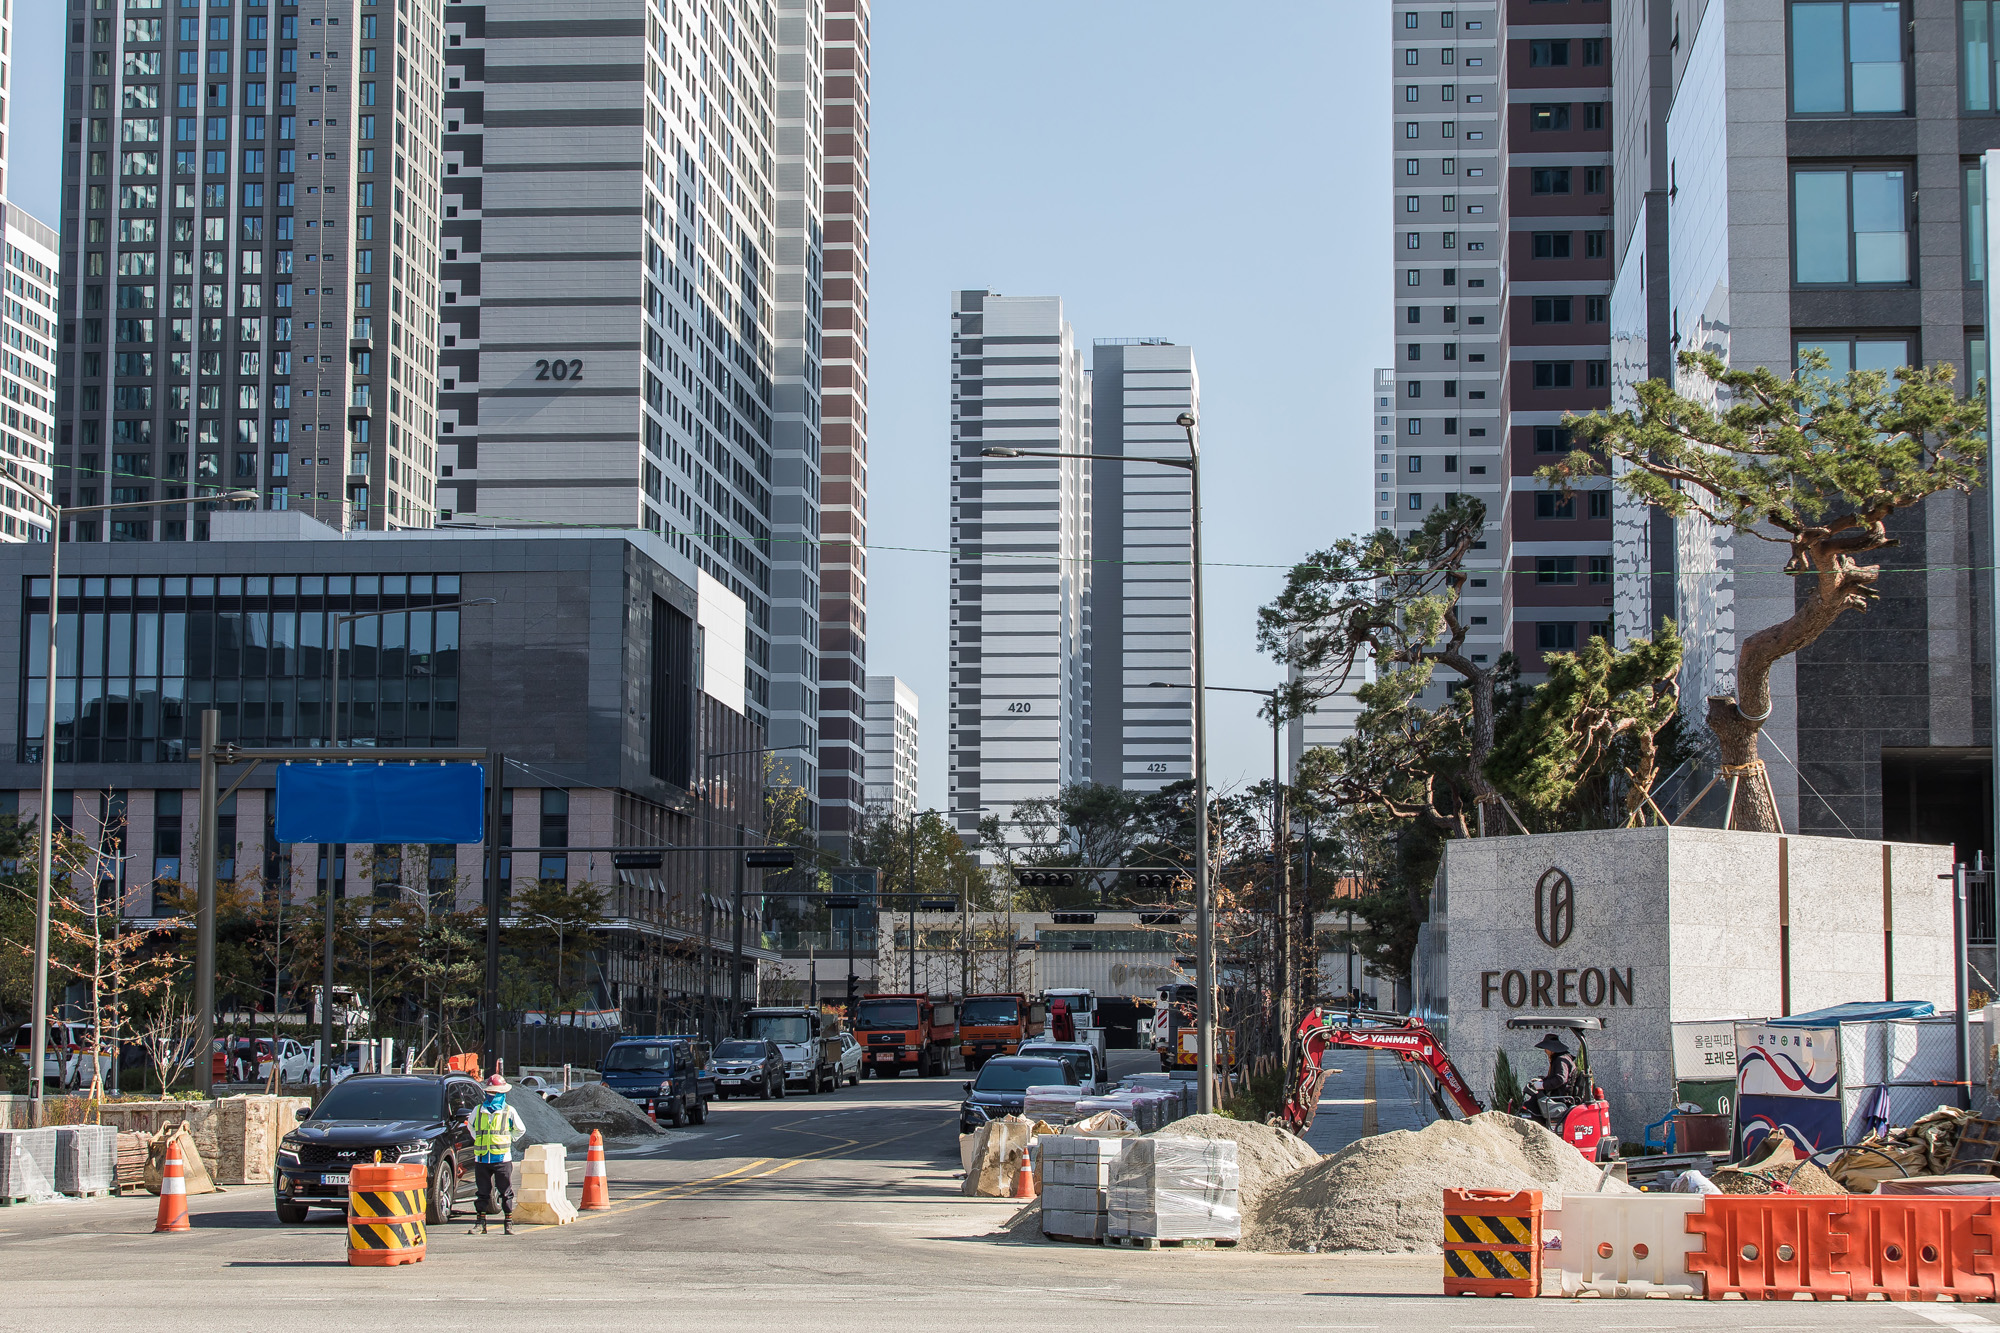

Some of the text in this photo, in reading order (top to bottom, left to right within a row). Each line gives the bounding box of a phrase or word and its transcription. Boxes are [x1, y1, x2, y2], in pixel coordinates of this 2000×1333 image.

[535, 359, 583, 381] 202
[1007, 702, 1031, 713] 420
[1147, 763, 1167, 772] 425
[1480, 967, 1633, 1008] FOREON
[1370, 1034, 1419, 1045] YANMAR
[1694, 1034, 1736, 1049] 올림픽파
[1704, 1051, 1736, 1065] 포레온
